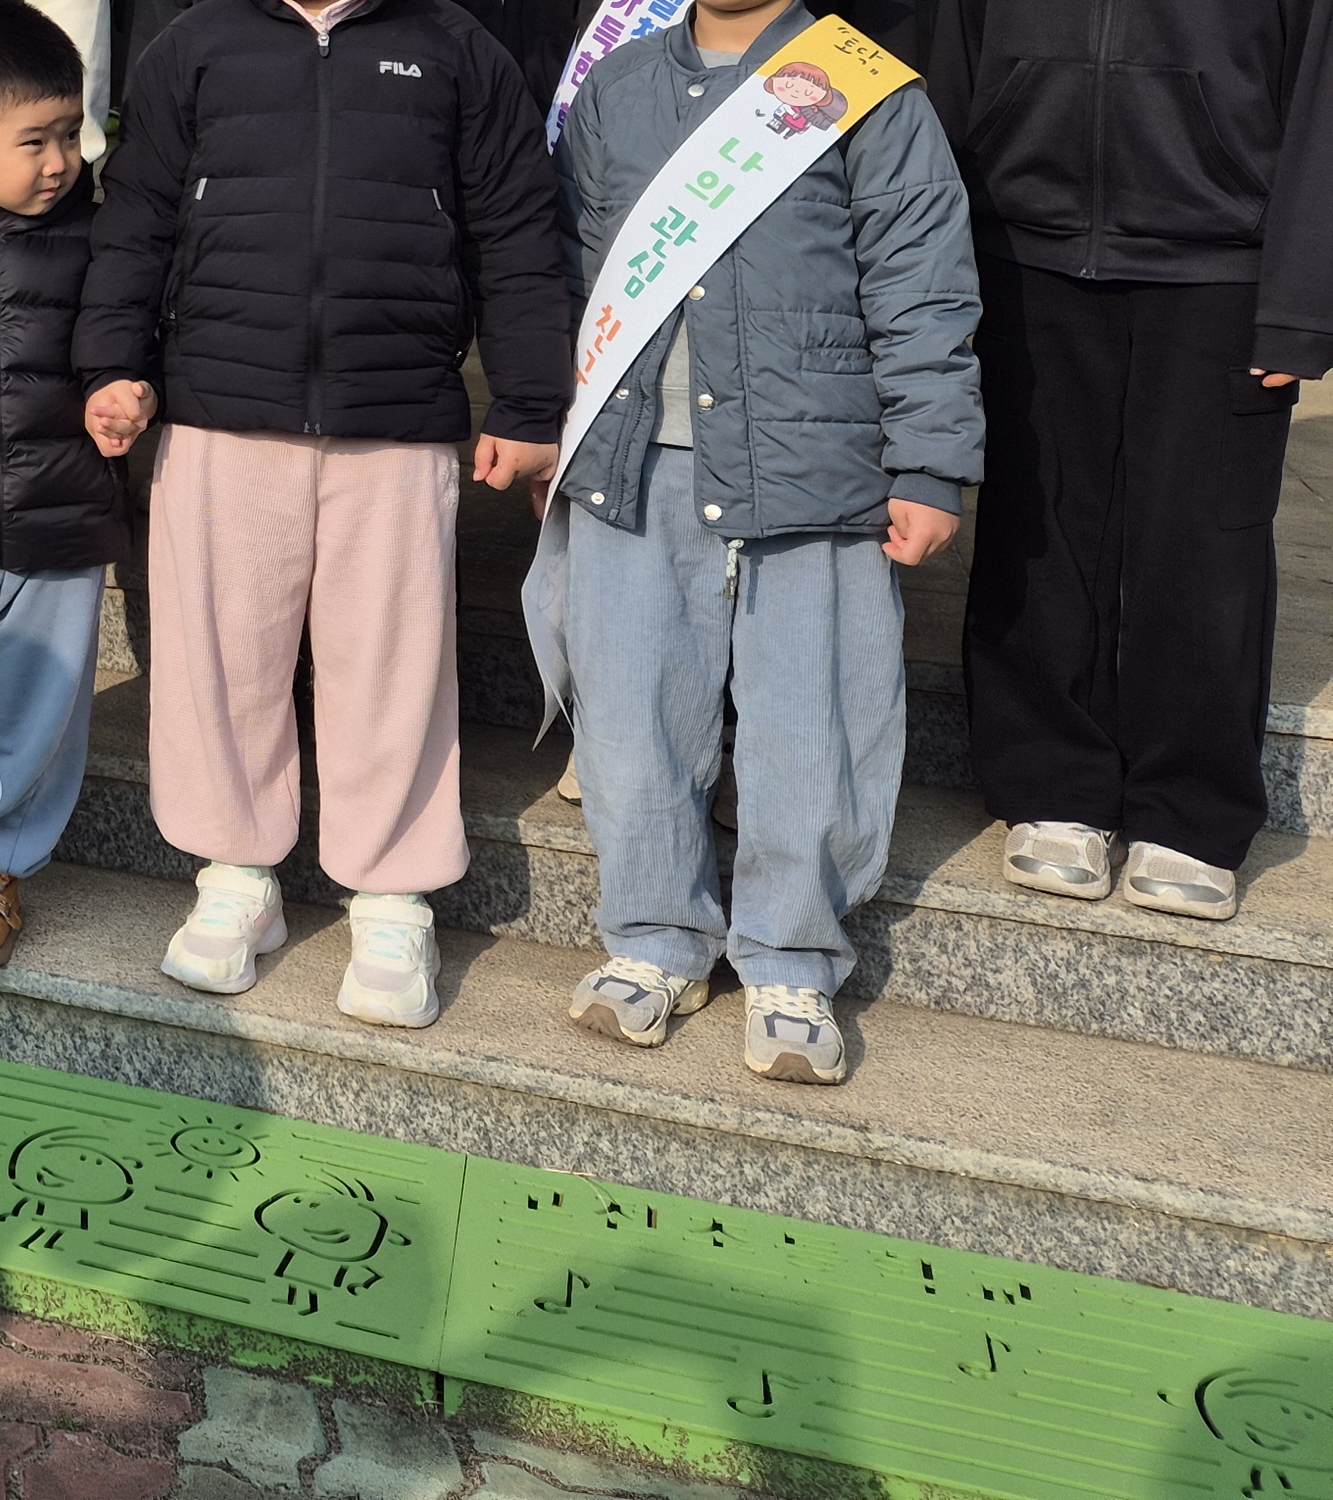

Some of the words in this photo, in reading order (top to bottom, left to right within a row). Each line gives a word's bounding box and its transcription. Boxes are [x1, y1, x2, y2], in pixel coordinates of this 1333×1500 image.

[379, 61, 422, 78] FILA
[684, 136, 765, 210] 나의
[623, 205, 700, 300] 관심
